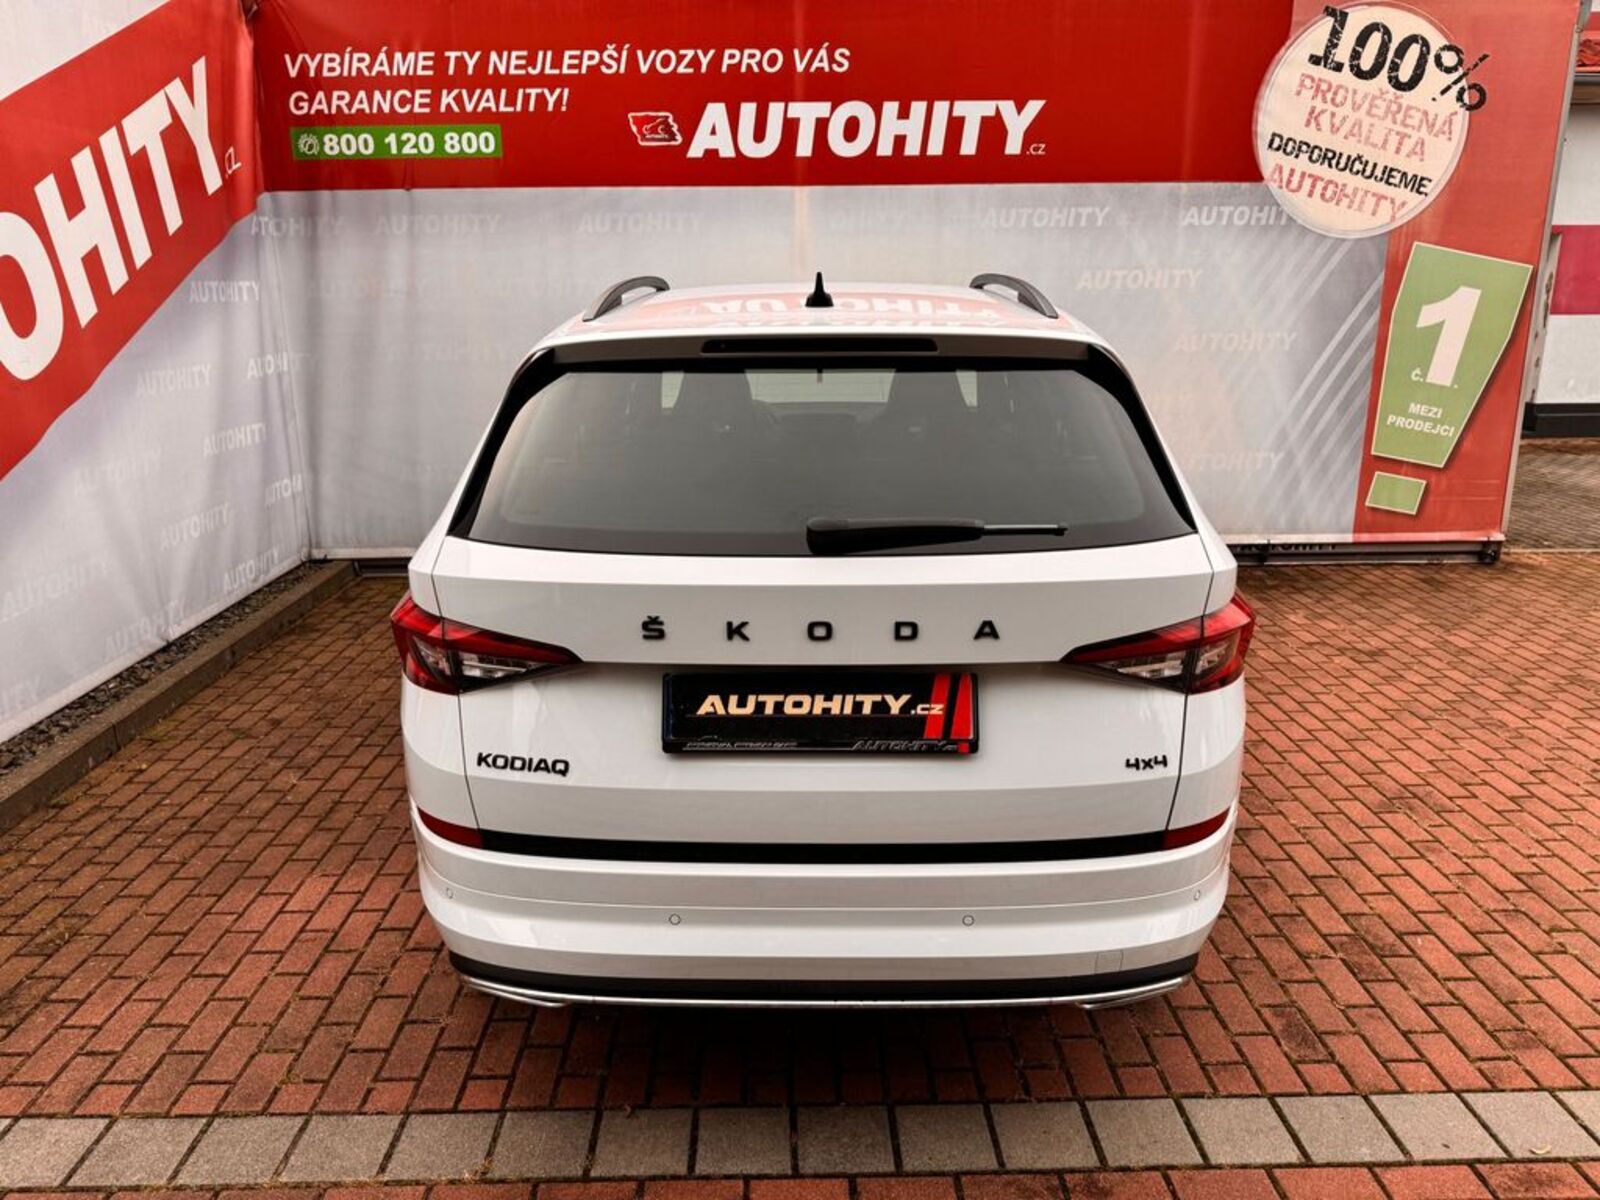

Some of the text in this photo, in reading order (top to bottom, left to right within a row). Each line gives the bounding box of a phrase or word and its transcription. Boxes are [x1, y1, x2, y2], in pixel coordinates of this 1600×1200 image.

[284, 42, 851, 78] VYBÍRÁME TY NEJLEPŠÍ VOZY PRO VÁS
[1308, 5, 1490, 112] 100%
[288, 87, 569, 115] GARANCE KVALITY!
[1295, 72, 1458, 142] PROVĚŘENÁ
[323, 131, 496, 155] 800 120 800
[1303, 105, 1427, 163] KVALITA
[1266, 131, 1433, 197] DOPORUČUJEME
[1269, 161, 1408, 224] AUTOHITY
[980, 206, 1111, 229] AUTOHITY
[190, 280, 261, 304] AUTOHITY
[1075, 269, 1203, 291] AUTOHITY
[1173, 331, 1298, 352] AUTOHITY
[1408, 403, 1443, 419] MEZI
[1387, 414, 1455, 437] PRODEJCI
[476, 751, 570, 777] KODIAQ
[1125, 754, 1168, 771] 4x4
